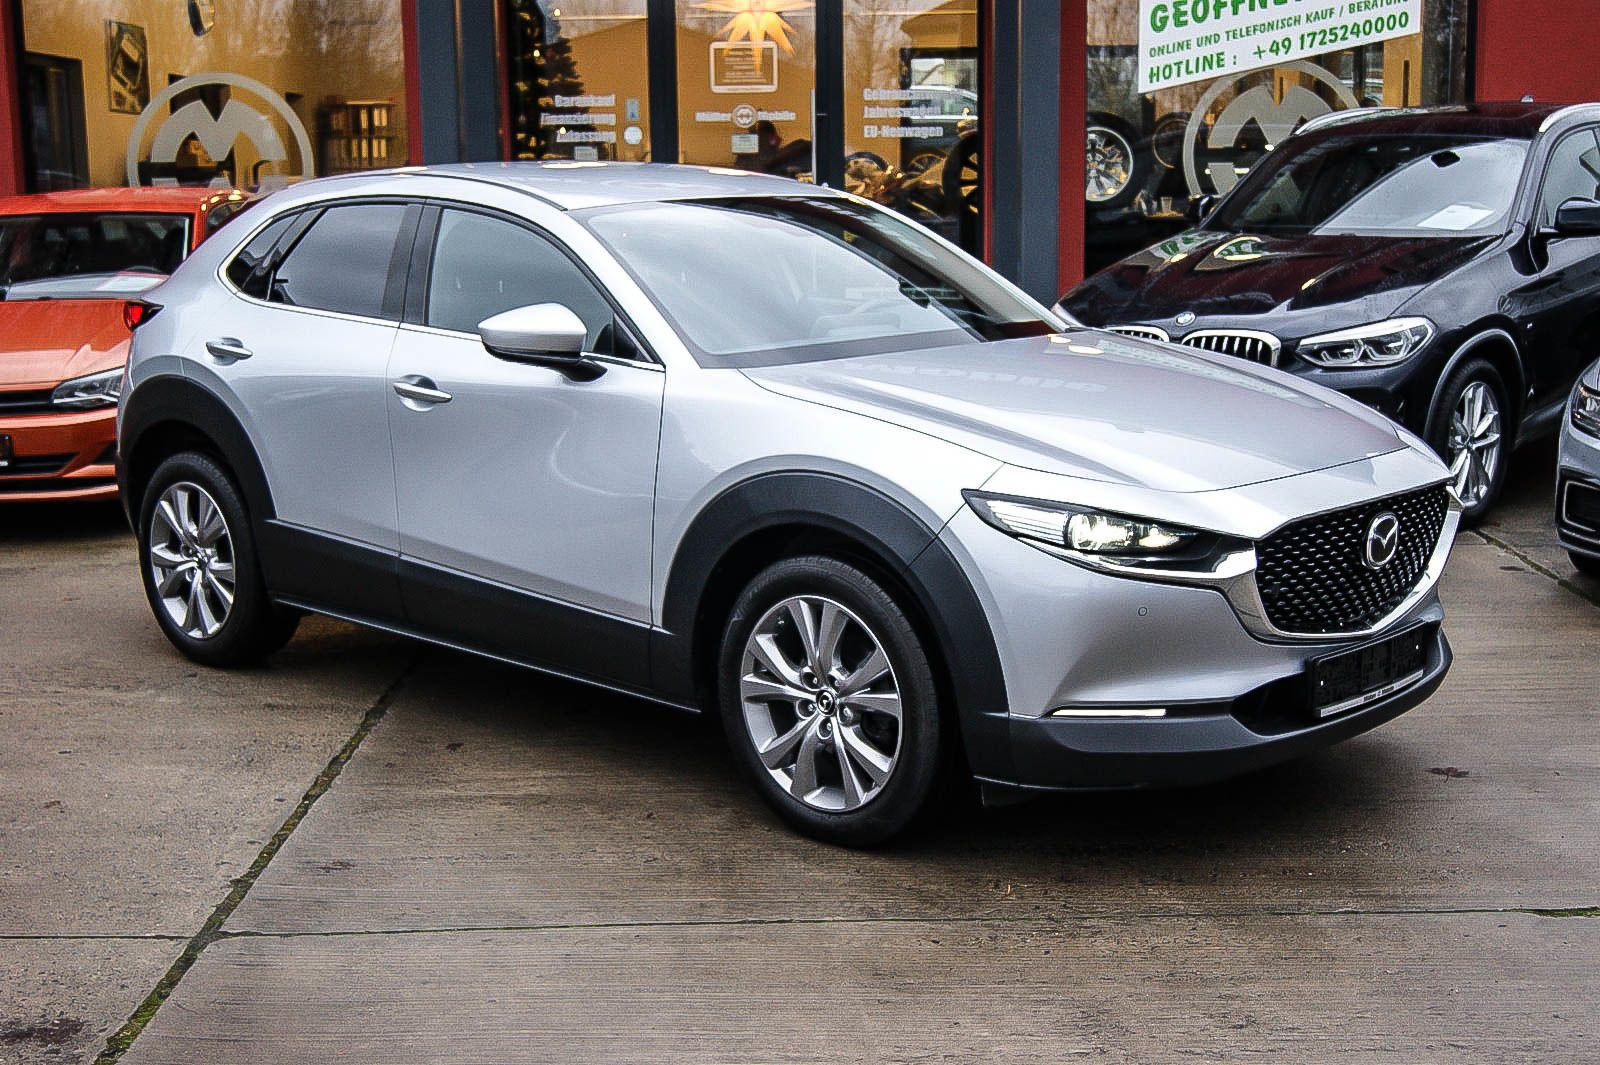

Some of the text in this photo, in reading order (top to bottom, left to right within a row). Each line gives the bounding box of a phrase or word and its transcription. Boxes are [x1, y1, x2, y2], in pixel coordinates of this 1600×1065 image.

[1148, 52, 1225, 84] HOTLINE
[1252, 37, 1292, 60] +49
[1299, 11, 1409, 50] 1725240000
[1149, 40, 1192, 58] ONLINE
[1196, 33, 1220, 48] UND
[1224, 15, 1301, 42] TELEFONISCH
[1305, 8, 1335, 24] KAUF
